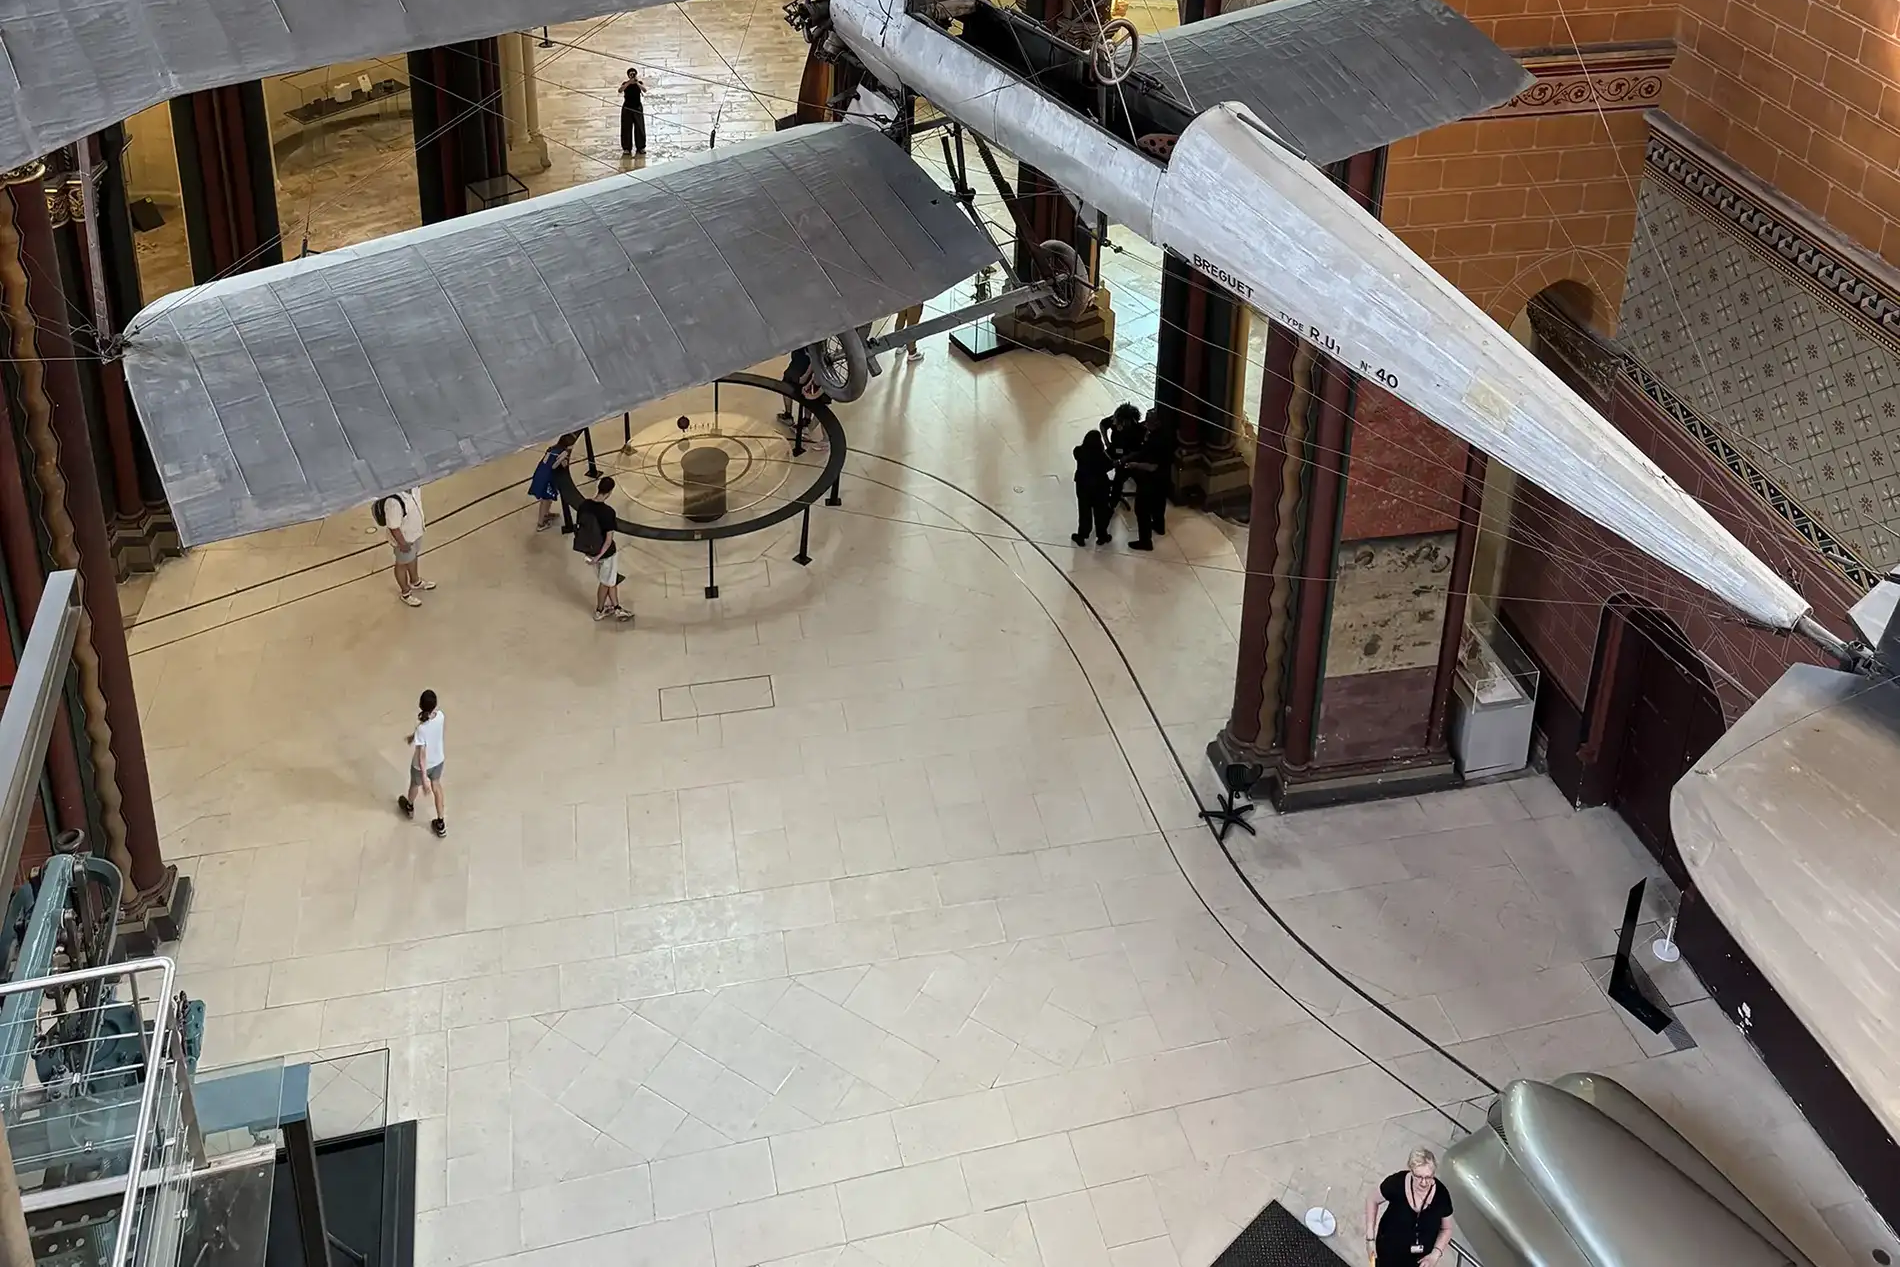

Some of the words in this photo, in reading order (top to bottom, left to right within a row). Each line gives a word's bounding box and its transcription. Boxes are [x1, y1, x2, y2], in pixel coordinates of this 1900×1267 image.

[1193, 253, 1254, 299] BREGUET
[1279, 311, 1304, 331] TYPE
[1375, 368, 1399, 388] 40
